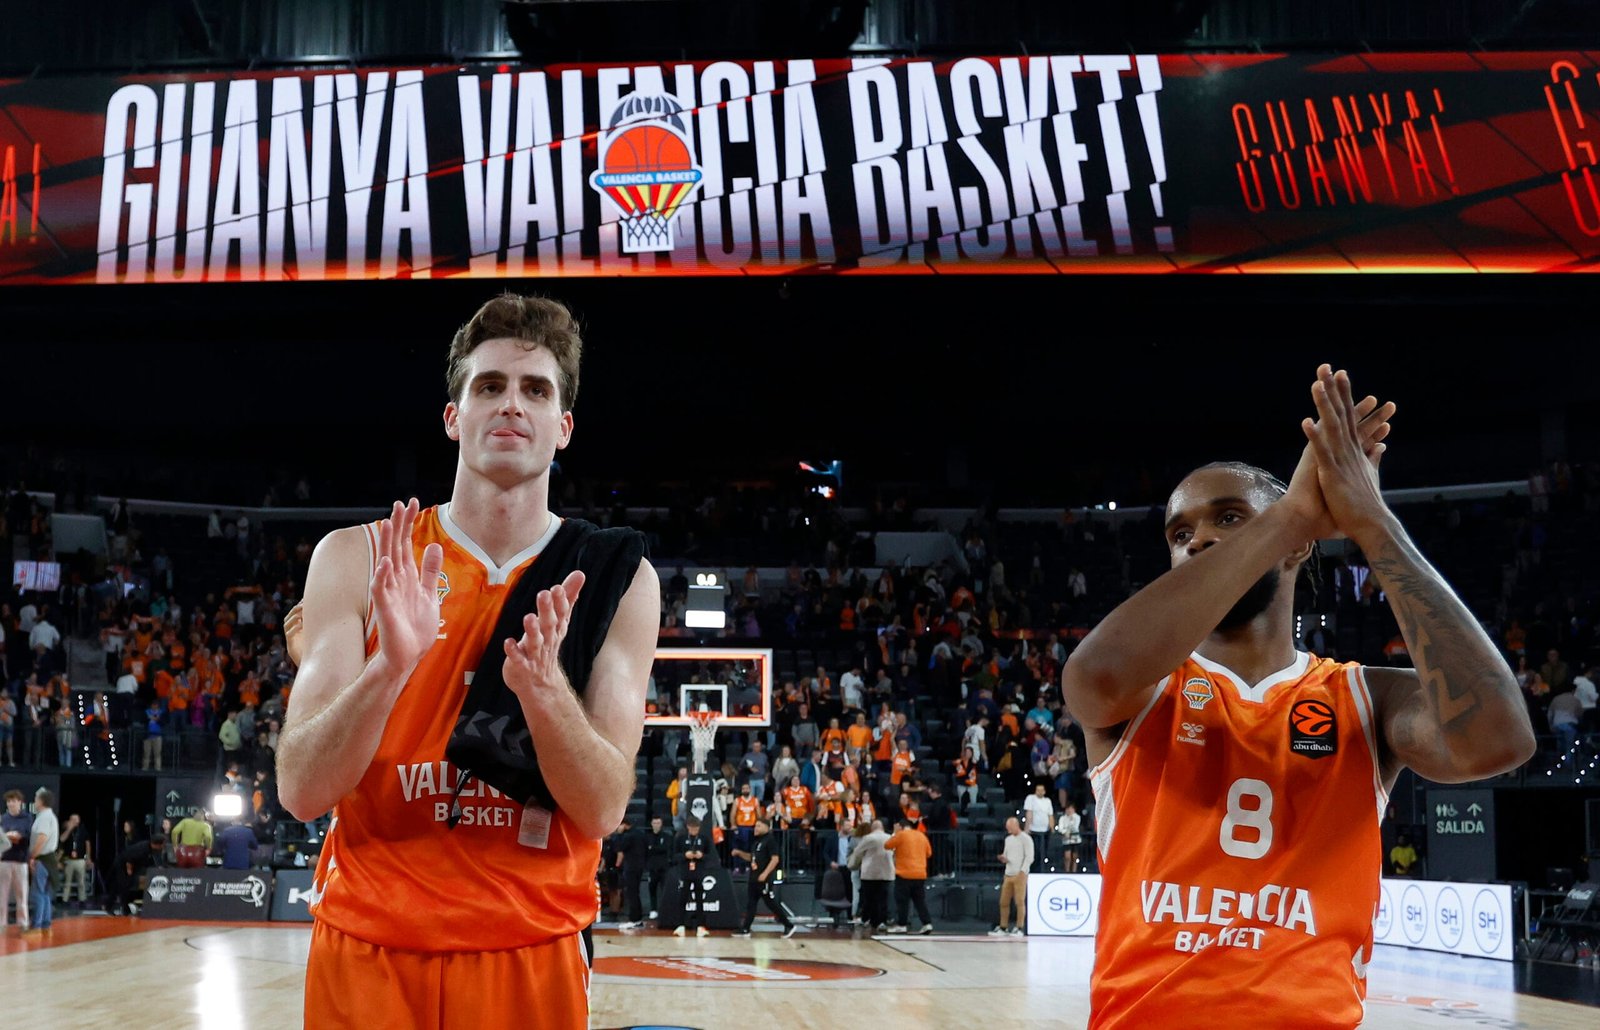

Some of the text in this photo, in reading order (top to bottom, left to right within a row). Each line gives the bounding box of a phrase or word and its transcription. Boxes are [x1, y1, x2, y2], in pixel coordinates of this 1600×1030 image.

[1231, 88, 1460, 213] GUANYA!
[96, 70, 432, 283] GUANYA
[847, 54, 1175, 268] BASKET!
[600, 171, 696, 185] VALENCIA BASKET
[397, 760, 513, 802] VALE
[165, 805, 199, 818] SALD
[434, 802, 515, 827] BSKET
[1219, 777, 1273, 860] 8
[1436, 820, 1485, 834] SALIDA
[1049, 897, 1079, 911] SH
[1140, 879, 1317, 937] VALENCIA
[1406, 905, 1422, 921] SH
[1441, 908, 1458, 925] SH
[1478, 911, 1497, 929] SH
